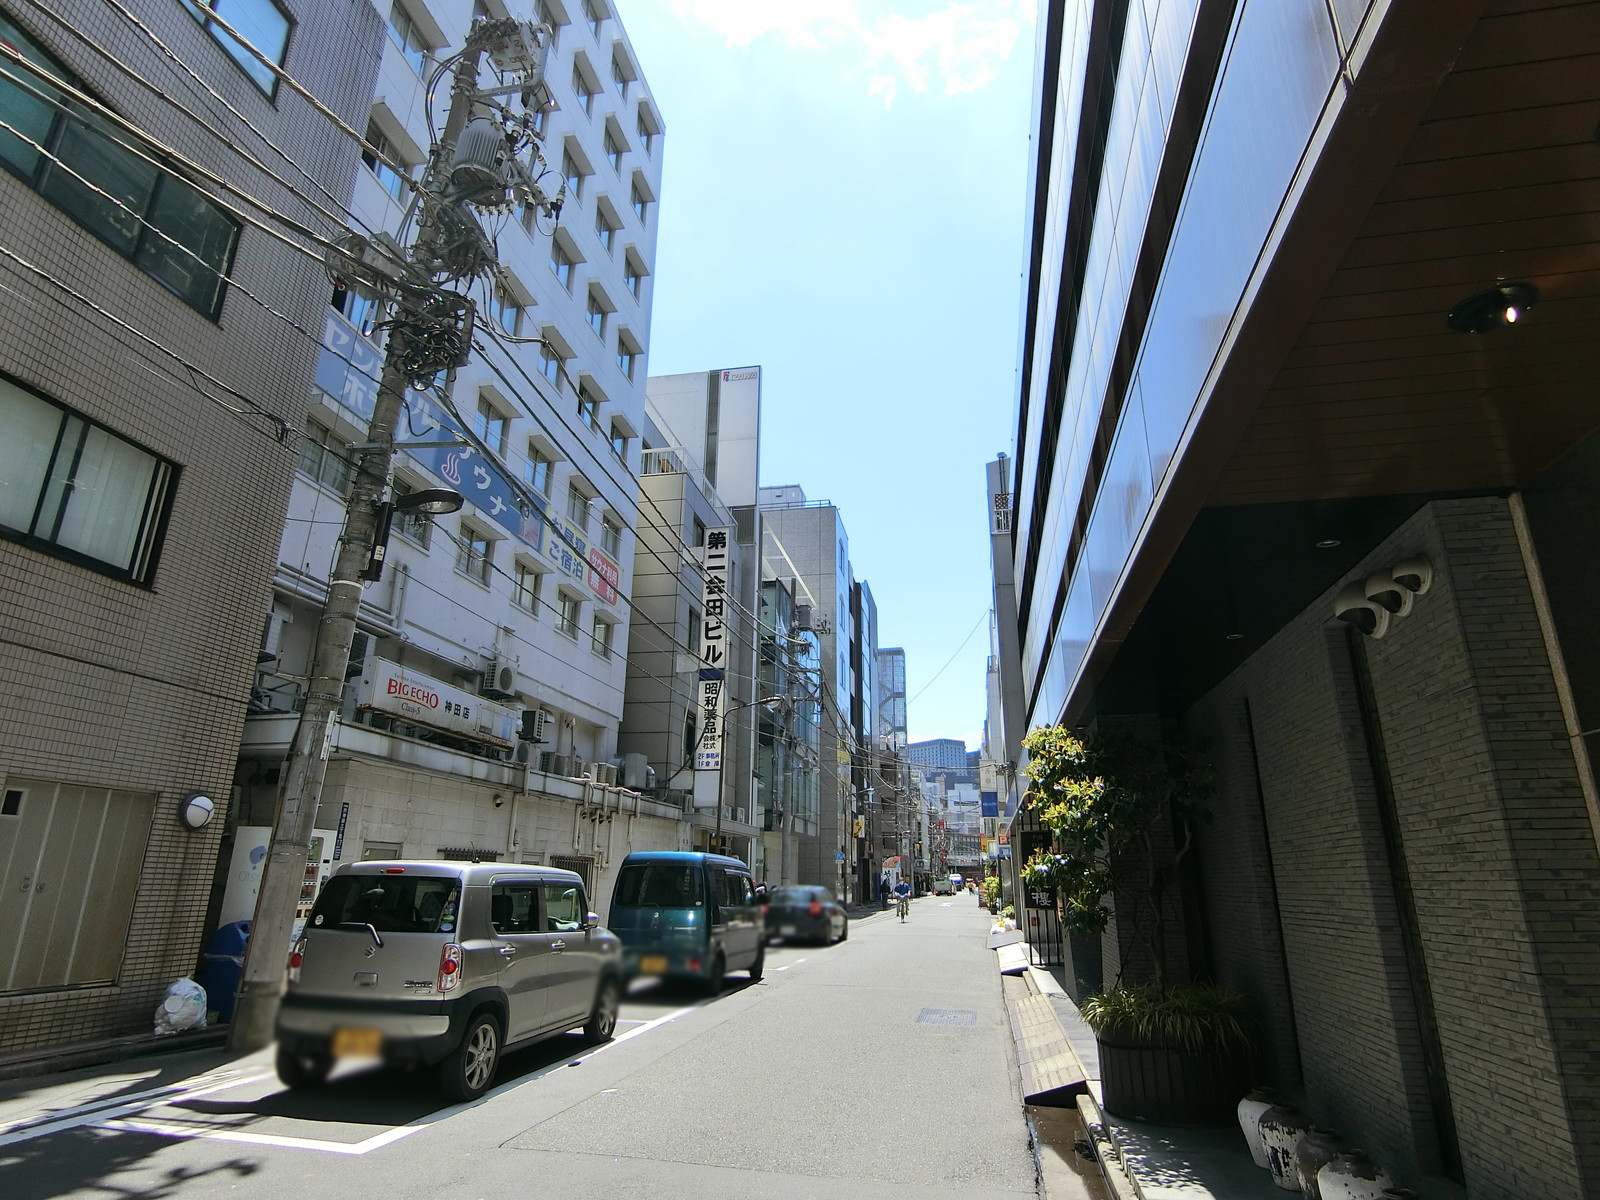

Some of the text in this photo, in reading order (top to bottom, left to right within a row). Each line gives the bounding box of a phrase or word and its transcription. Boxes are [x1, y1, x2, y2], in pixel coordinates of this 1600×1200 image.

[549, 540, 584, 581] ご宿泊
[704, 531, 727, 664] 第二会田ビル
[444, 699, 470, 720] 神田店
